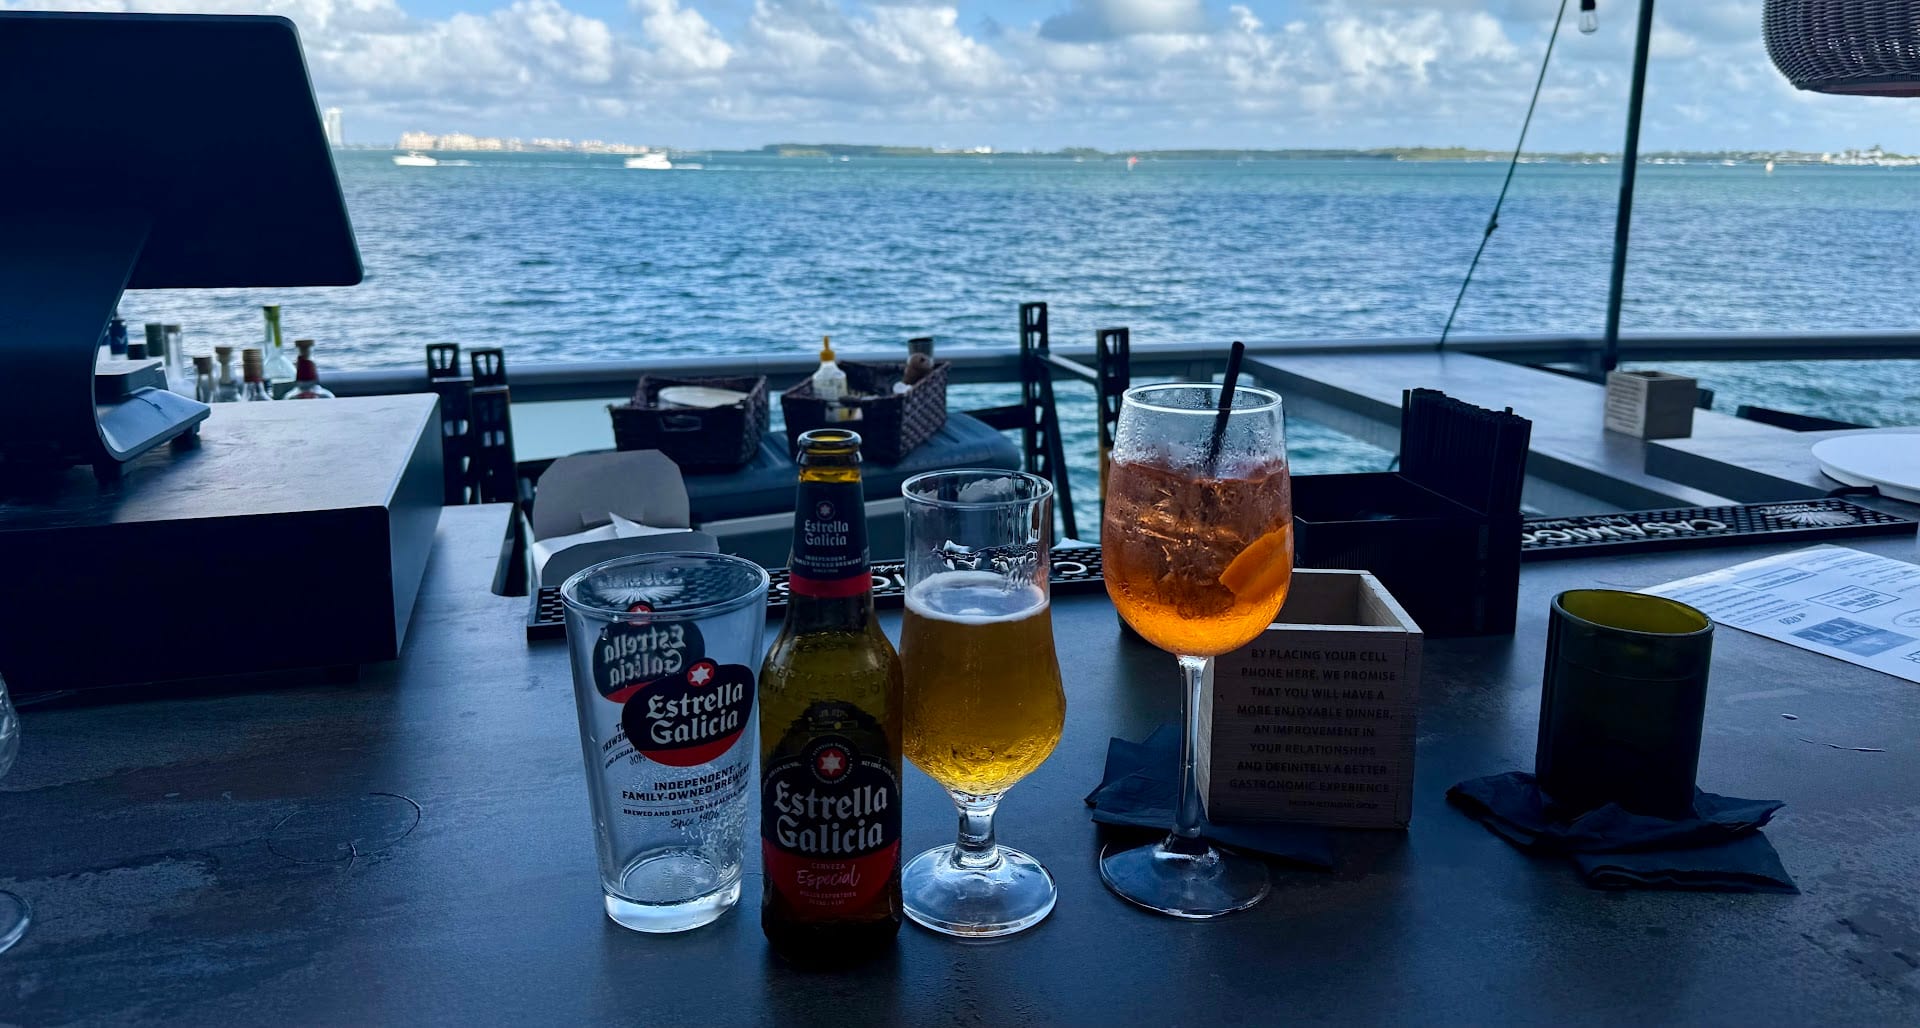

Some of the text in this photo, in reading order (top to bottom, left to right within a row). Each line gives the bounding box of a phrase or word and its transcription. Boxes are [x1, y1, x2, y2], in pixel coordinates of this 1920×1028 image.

[804, 519, 849, 533] Estrella
[805, 532, 848, 546] Galicia
[1251, 649, 1387, 662] BY PLACING YOUR CELL
[1241, 667, 1282, 678] PHONE
[1322, 670, 1340, 680] WE
[1343, 670, 1396, 681] PROMISE
[1250, 687, 1385, 700] THAT YOU WILL HAVE A
[645, 683, 744, 720] Estrella
[1237, 704, 1271, 715] MORE
[1274, 706, 1342, 717] ENJOYABLE
[650, 708, 738, 745] Galicia
[1253, 725, 1376, 737] AN IMPROVEMENT IN
[1249, 743, 1377, 755] YOUR RELATIONSHIPS
[1237, 761, 1387, 775] AND DEFINITELY A BETTER
[622, 784, 713, 802] FAMILY-OWNED
[714, 764, 750, 791] BREWERY
[654, 765, 734, 791] INDEPENDENT
[1229, 778, 1390, 793] GASTRONOMIC EXPERIENCE
[773, 780, 889, 821] Estrella
[623, 808, 653, 817] BREWED
[654, 809, 670, 817] AND
[672, 805, 705, 816] BOTTLED
[776, 814, 884, 855] Galicia
[796, 864, 861, 890] Especial
